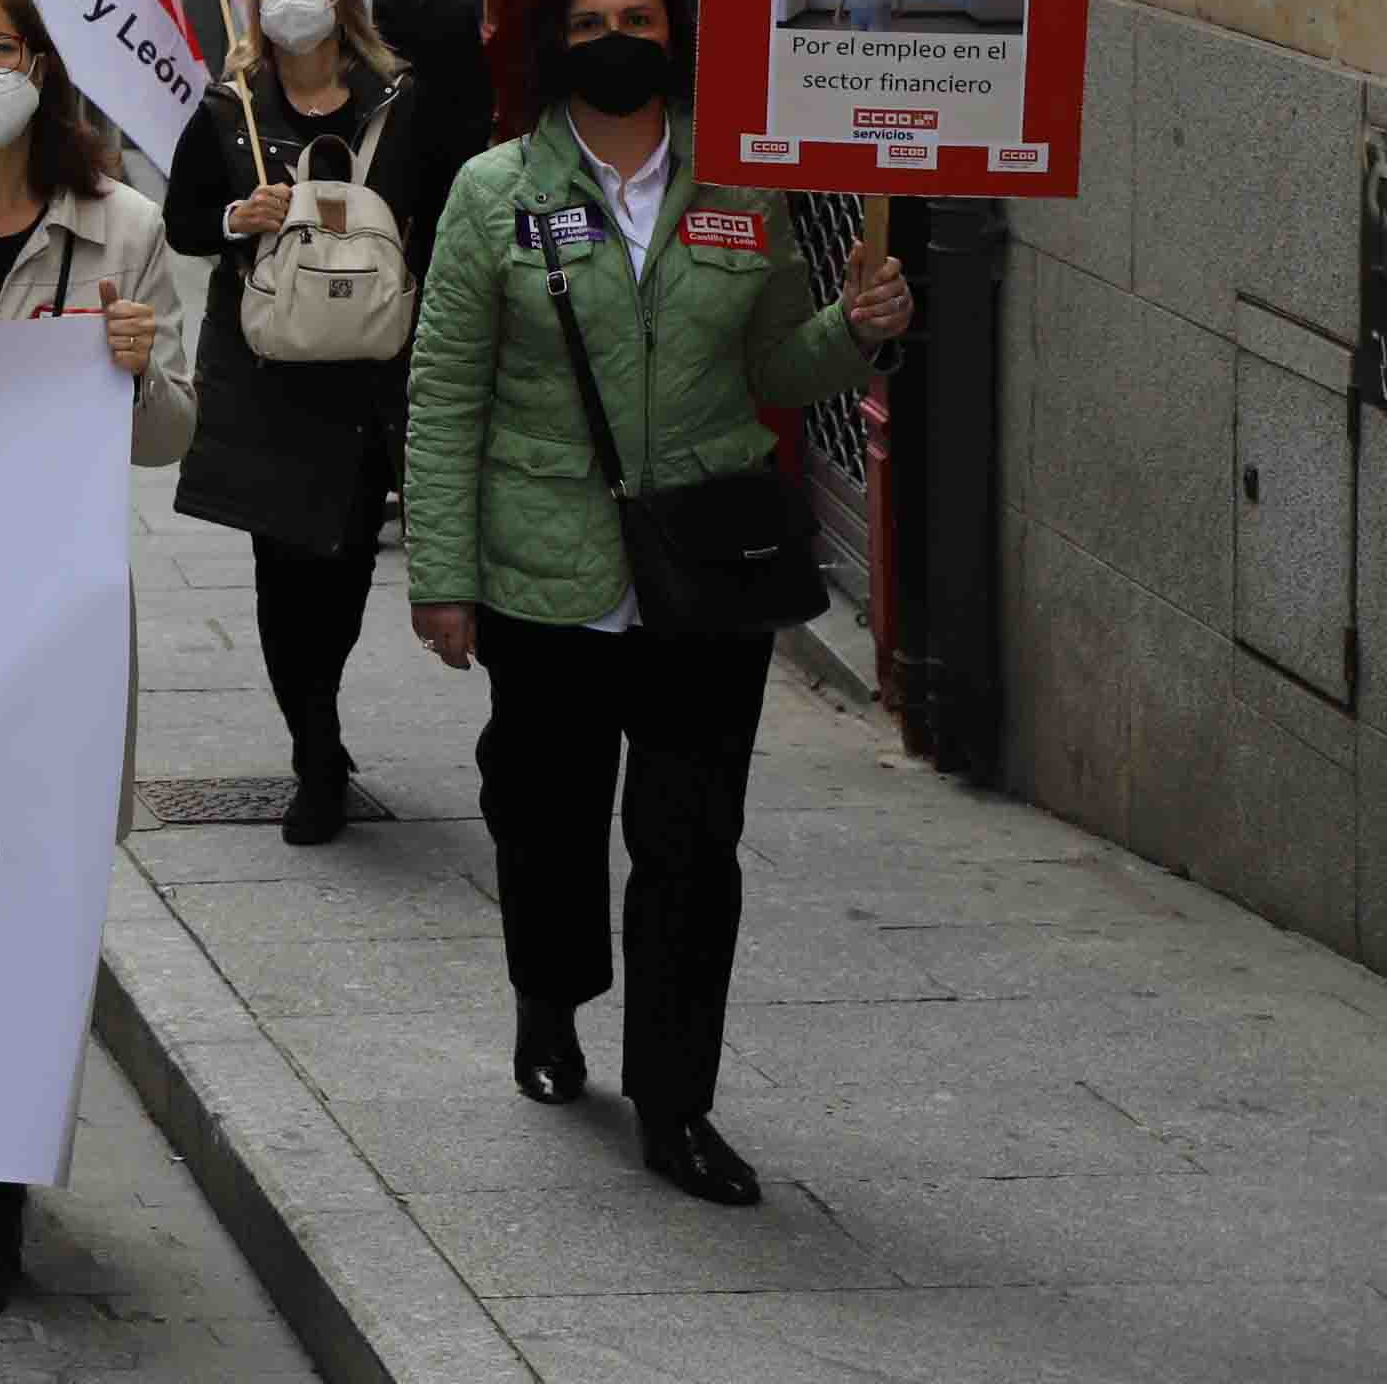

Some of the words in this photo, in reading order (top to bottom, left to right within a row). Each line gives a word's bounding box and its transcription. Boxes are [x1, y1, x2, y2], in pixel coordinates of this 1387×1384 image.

[792, 36, 830, 56] Por
[836, 37, 856, 57] el
[861, 39, 947, 62] empleo
[952, 44, 980, 60] en
[987, 41, 1007, 60] el
[116, 13, 194, 106] León
[802, 73, 874, 90] sector
[879, 72, 993, 94] financiero
[857, 112, 912, 126] CCOO
[852, 129, 915, 141] servicios
[752, 141, 788, 153] CCOO
[890, 146, 926, 158] CCOO
[1000, 150, 1037, 161] CCOO
[690, 215, 749, 233] CCOO
[689, 232, 724, 243] Castilla
[733, 236, 758, 247] León
